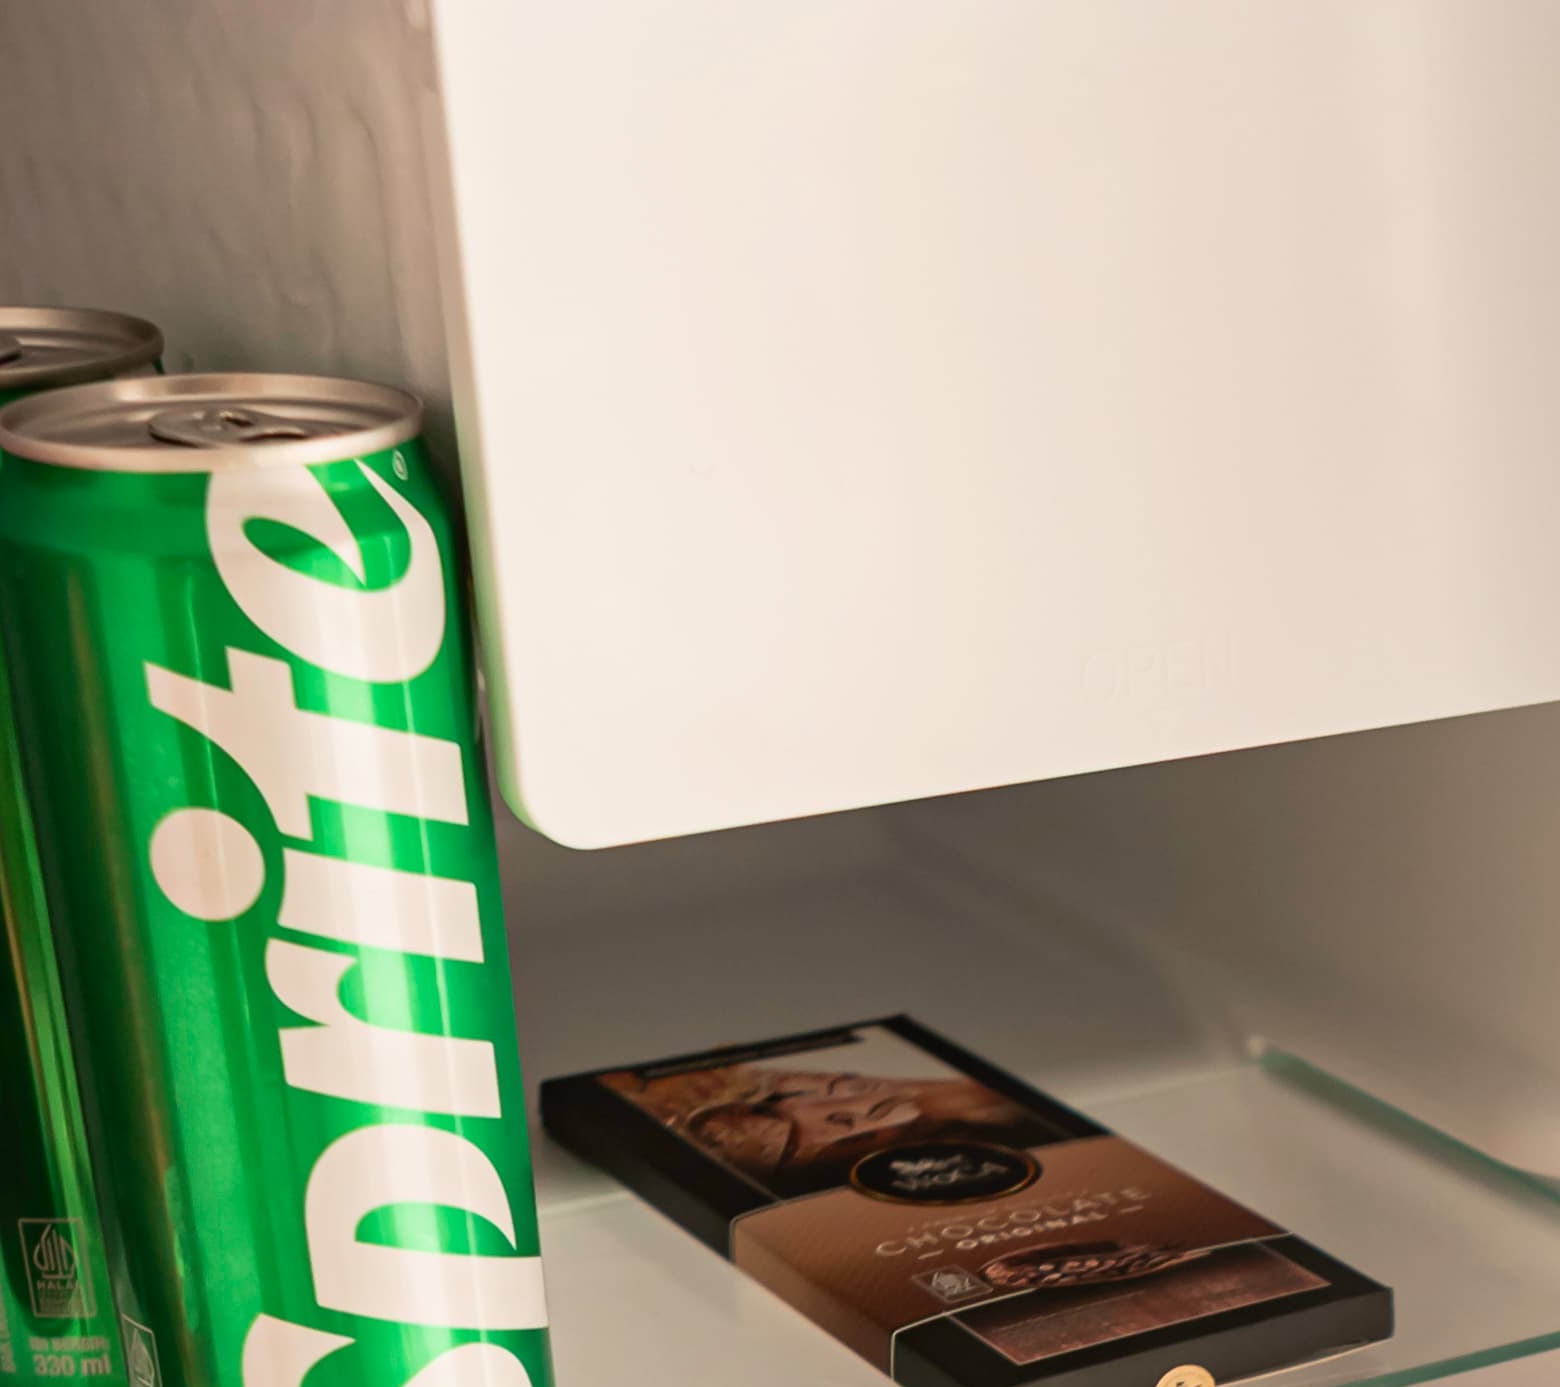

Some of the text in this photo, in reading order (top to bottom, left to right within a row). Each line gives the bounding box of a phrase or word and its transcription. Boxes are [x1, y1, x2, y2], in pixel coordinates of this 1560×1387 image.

[876, 1186, 1151, 1257] CHOCOLATE
[32, 1353, 112, 1376] 330 ml
